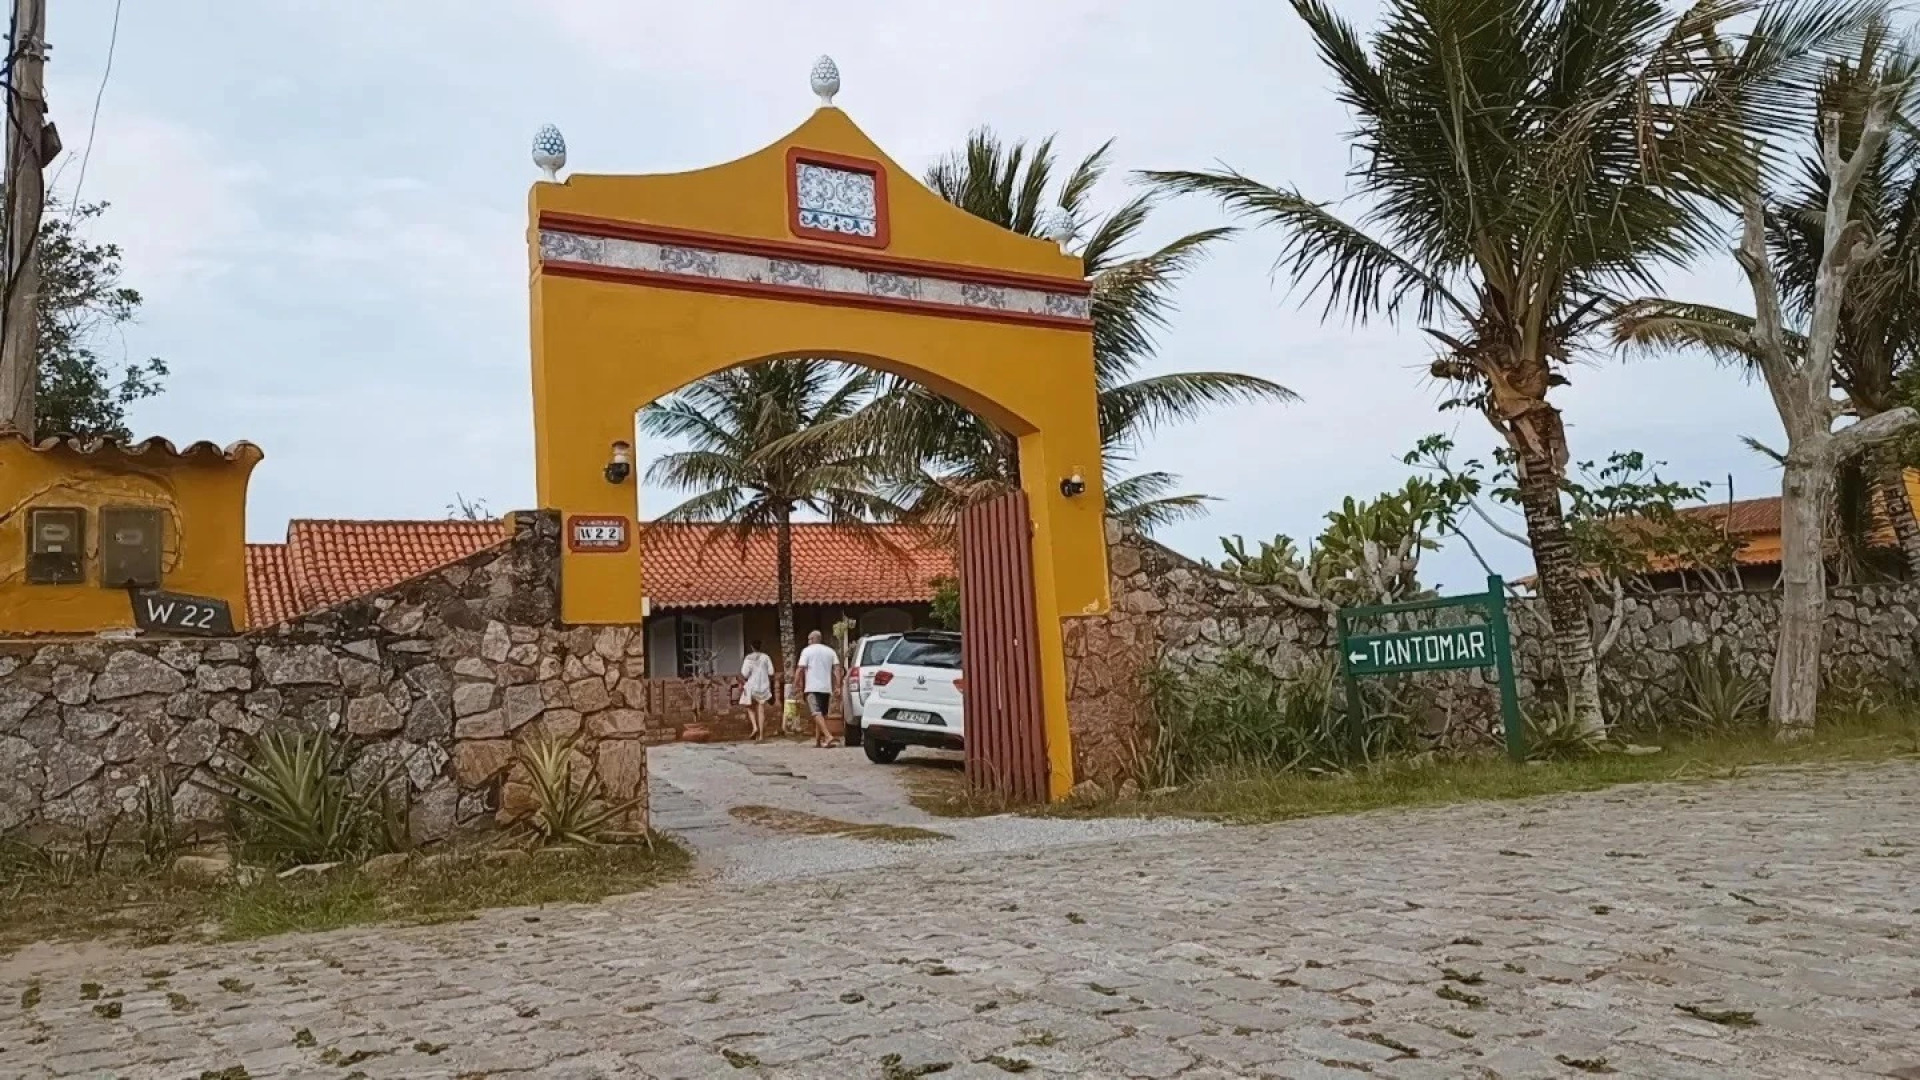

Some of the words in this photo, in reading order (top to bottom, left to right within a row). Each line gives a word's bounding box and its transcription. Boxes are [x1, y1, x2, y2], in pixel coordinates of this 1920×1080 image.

[595, 528, 617, 540] 22
[147, 598, 175, 624] W
[180, 605, 216, 629] 22
[1368, 631, 1486, 666] TANTOMAR
